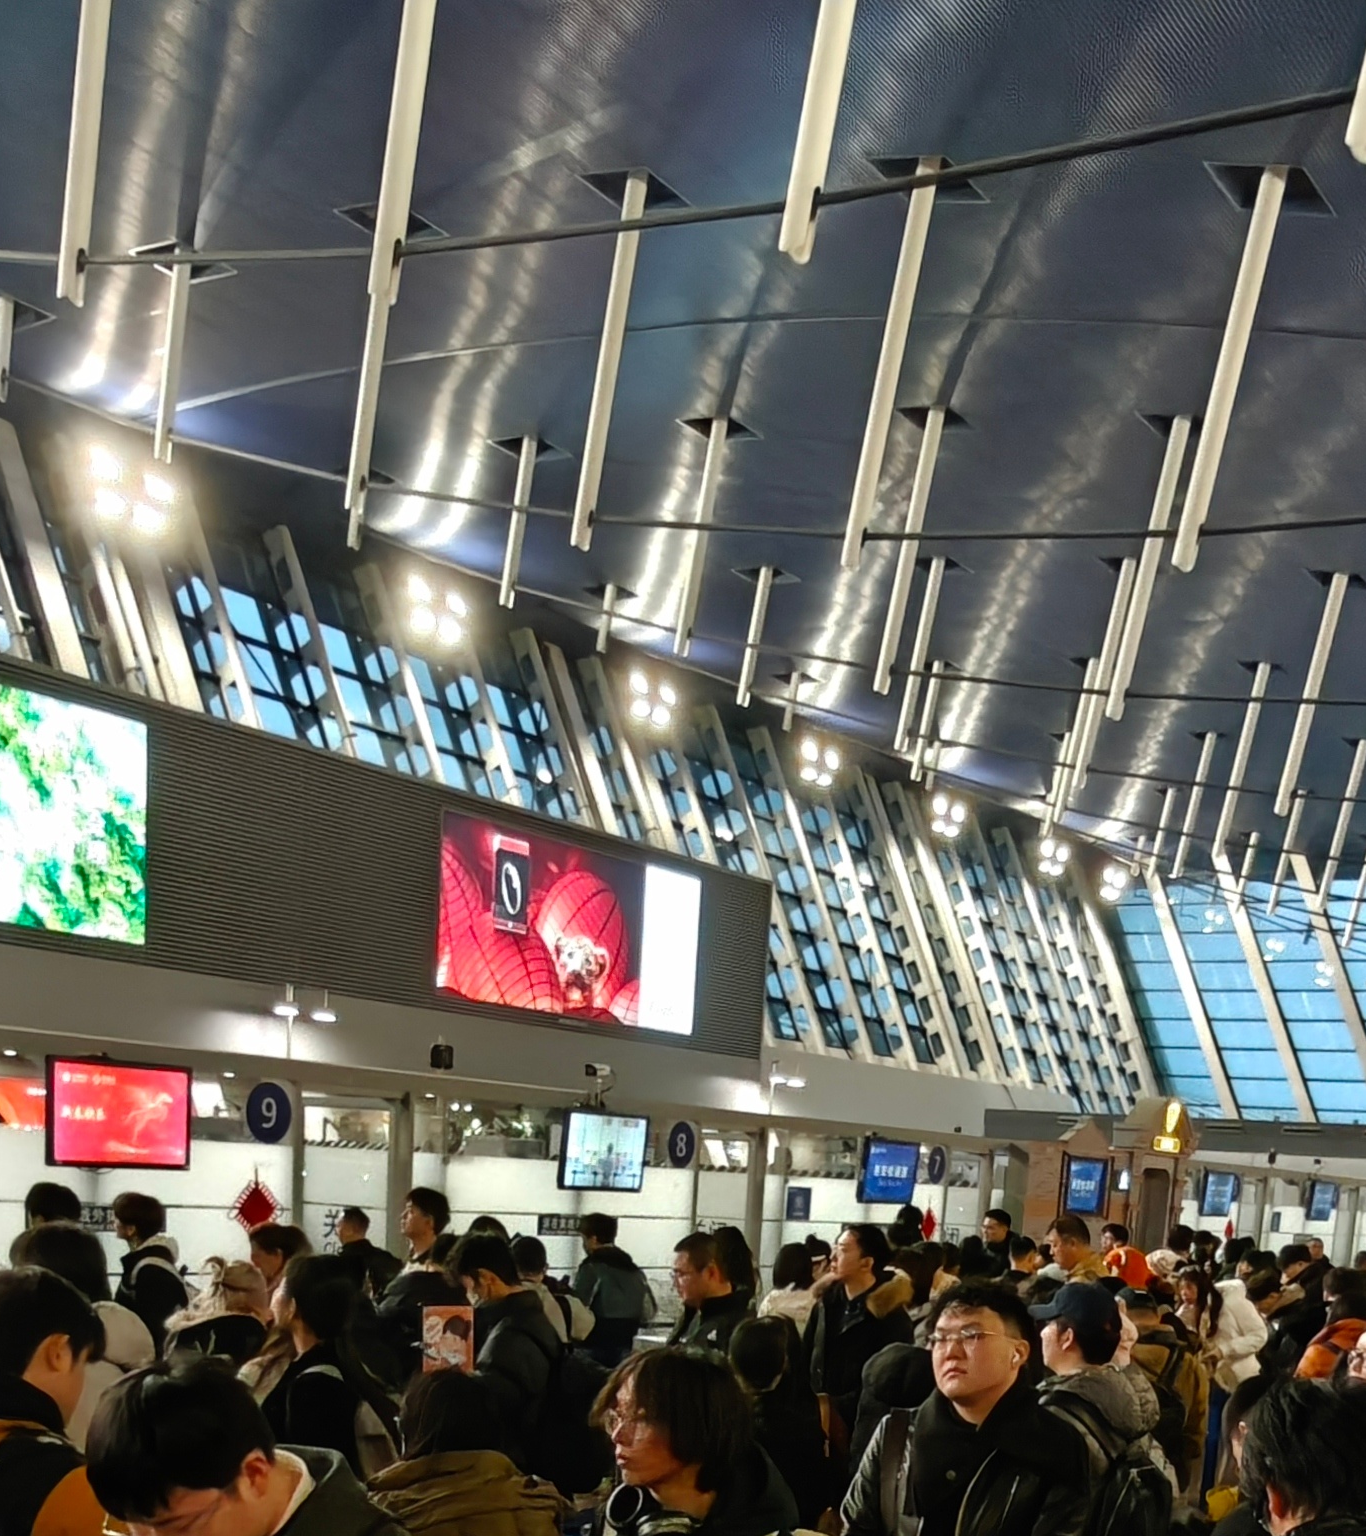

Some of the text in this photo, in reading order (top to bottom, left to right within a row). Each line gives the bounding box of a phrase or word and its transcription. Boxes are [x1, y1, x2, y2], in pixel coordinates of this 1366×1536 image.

[261, 1097, 278, 1129] 9
[676, 1133, 687, 1158] 8
[934, 1155, 941, 1174] 7
